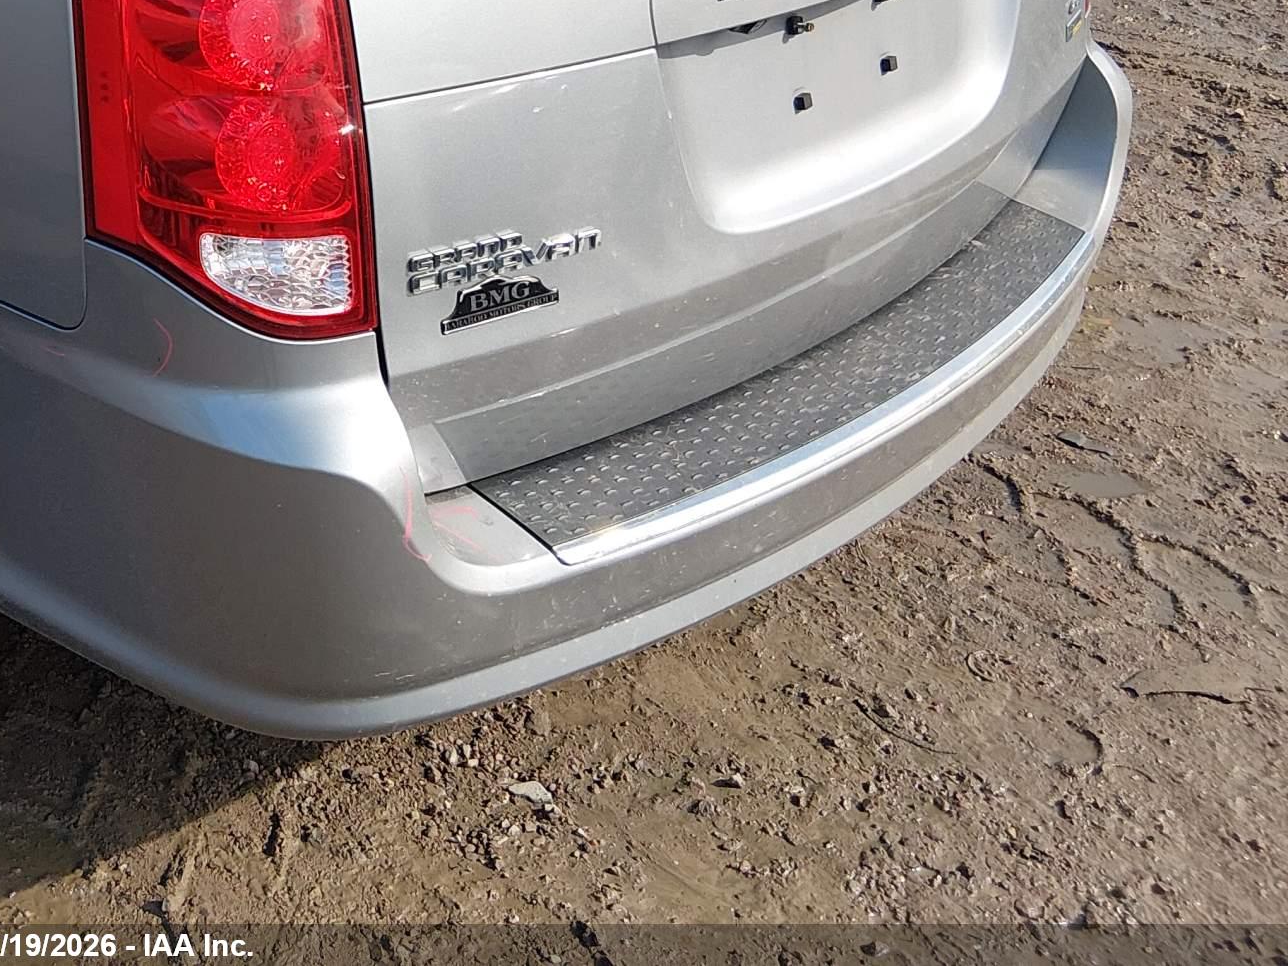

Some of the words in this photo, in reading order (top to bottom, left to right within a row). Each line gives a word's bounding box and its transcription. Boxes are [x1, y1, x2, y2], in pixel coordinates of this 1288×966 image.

[407, 229, 523, 275] GRAND
[407, 226, 602, 297] CARAVAN
[469, 281, 531, 312] BMG
